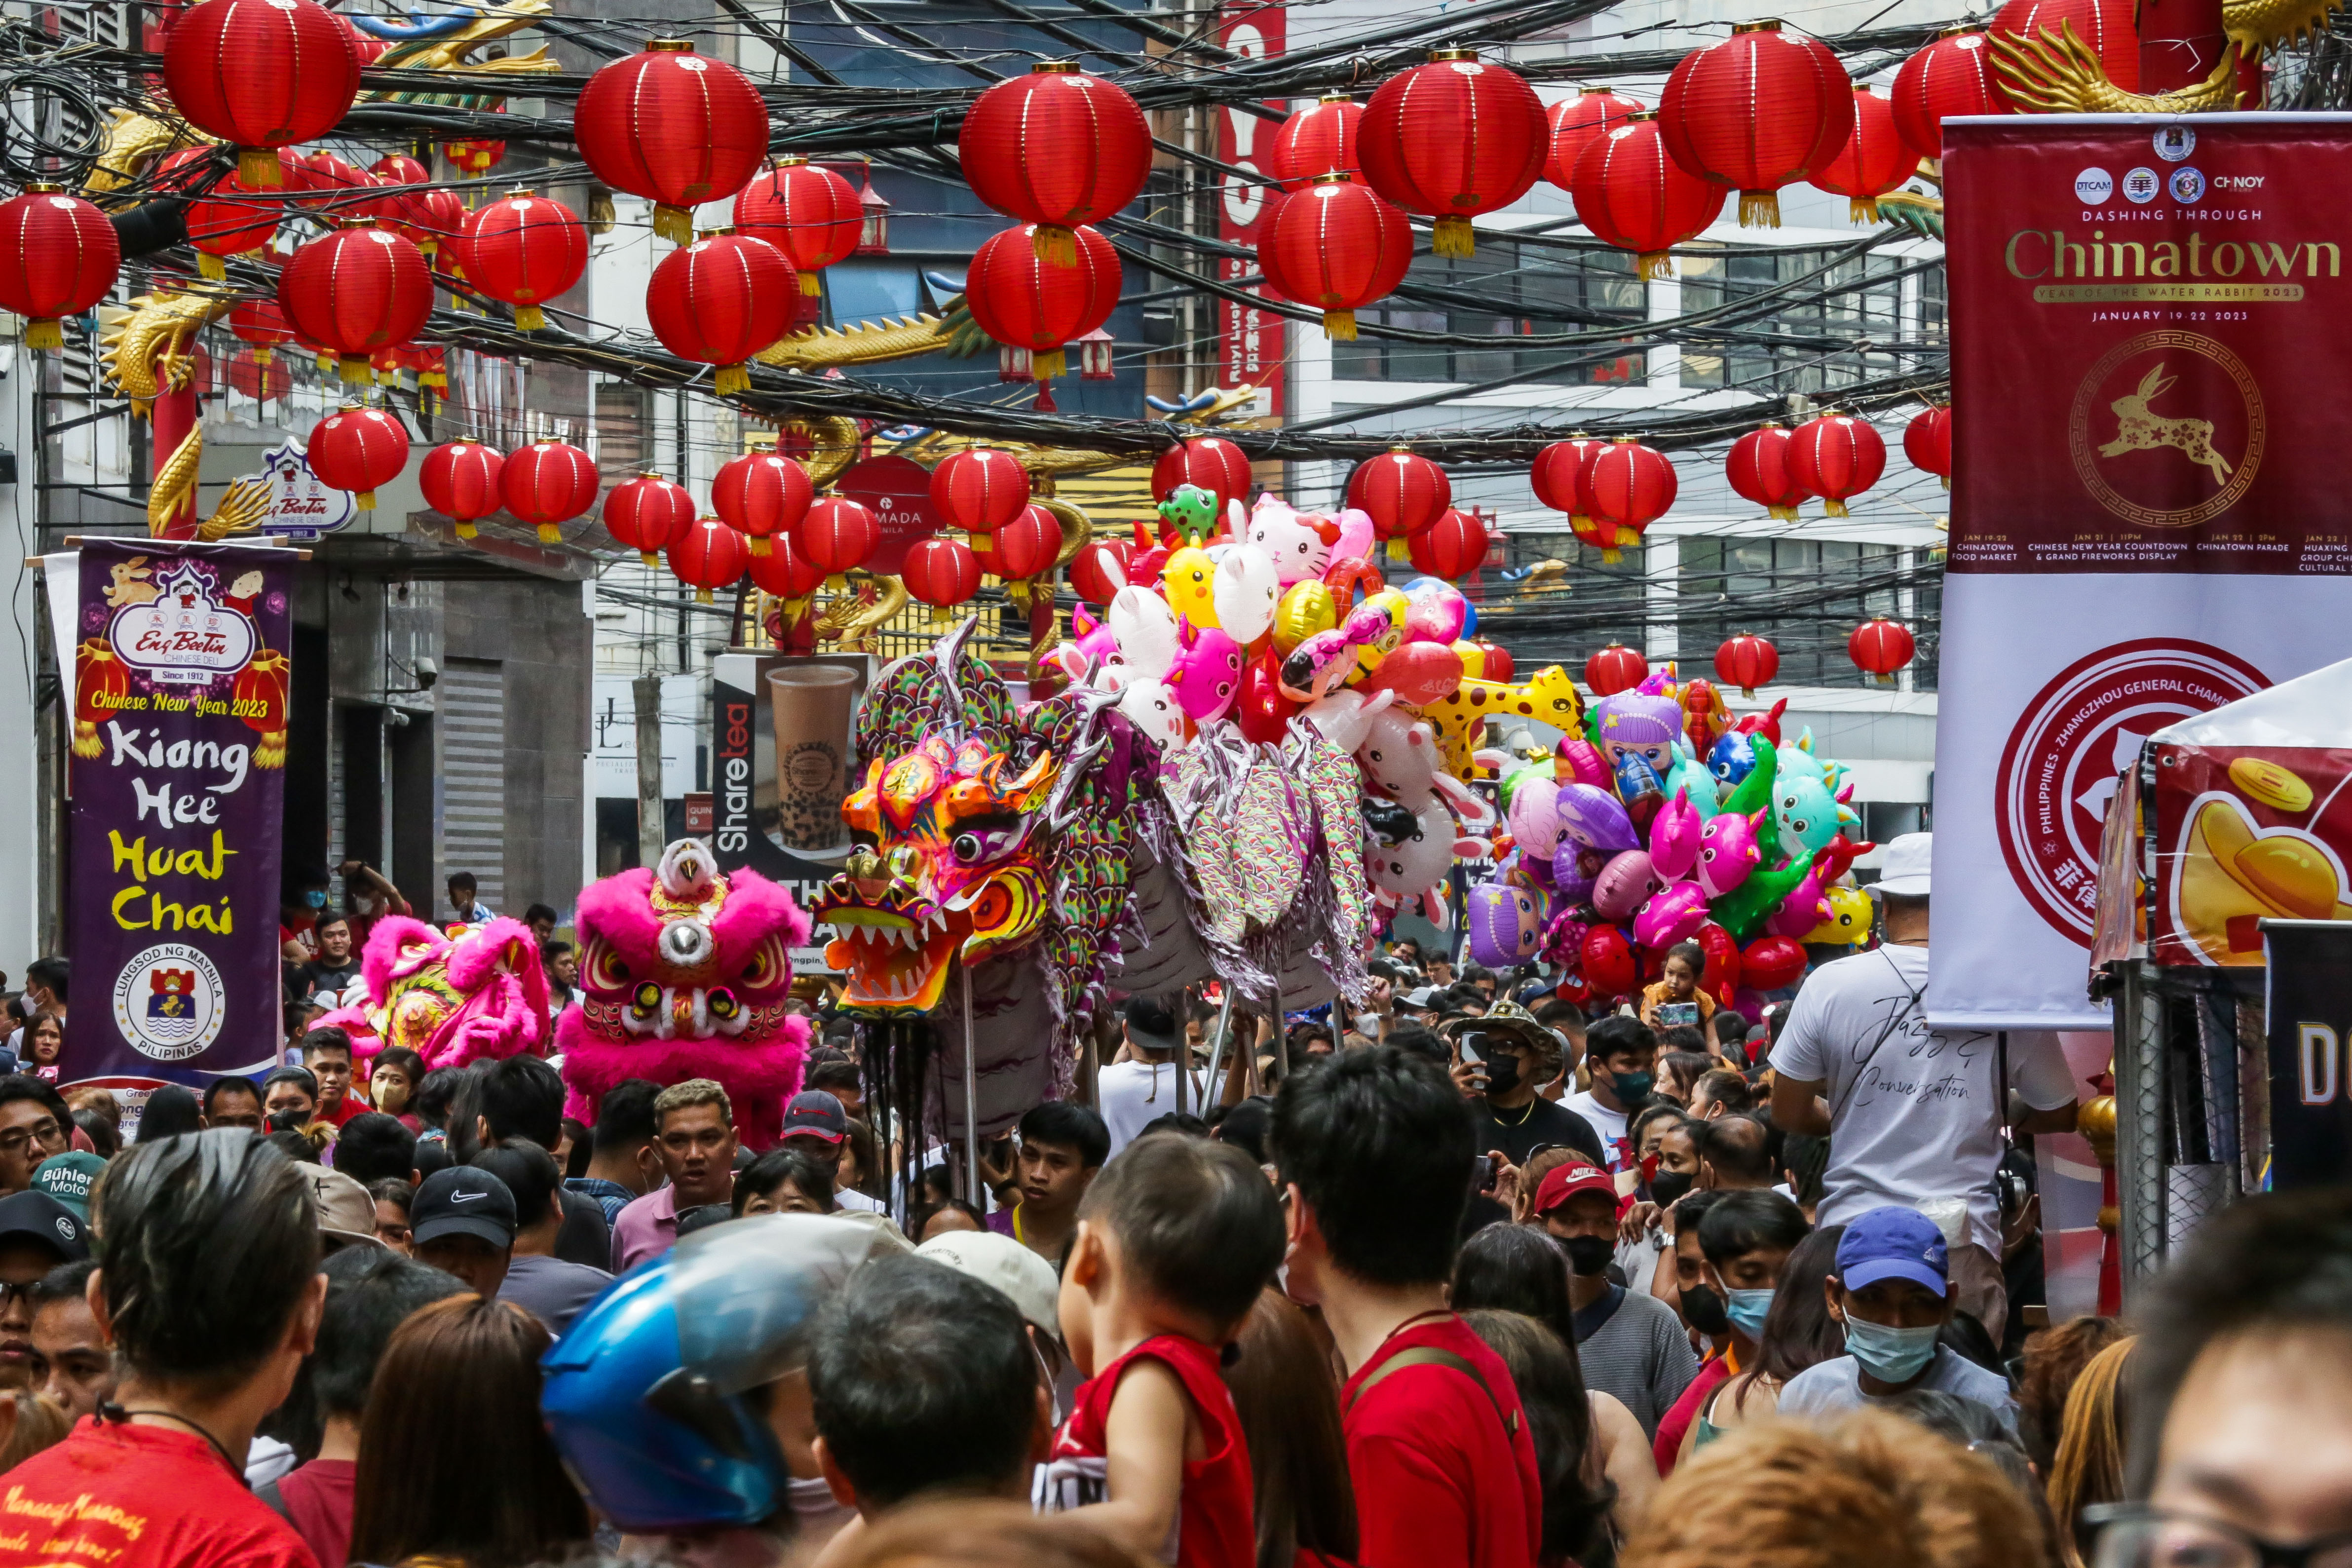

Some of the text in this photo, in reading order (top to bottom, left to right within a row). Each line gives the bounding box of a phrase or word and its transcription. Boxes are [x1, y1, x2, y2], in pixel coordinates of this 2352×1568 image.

[2077, 181, 2111, 191] DTCAM
[2083, 210, 2262, 222] DASHING THROUGH
[2004, 229, 2341, 279] Chinatown
[2039, 288, 2300, 297] YEAR OF THE WATER RABBIT 2023
[1230, 301, 1241, 341] Luck
[2092, 311, 2162, 322] JANUARY
[2215, 312, 2248, 321] 2023
[1229, 344, 1242, 382] Ruyi
[875, 512, 922, 524] MADA
[164, 653, 219, 665] CHINESE DELI
[162, 671, 204, 681] Since 1912
[91, 689, 268, 718] Chinese New Year 2023
[107, 720, 249, 794] Kiang
[2039, 753, 2059, 834] PHILIPPINES
[2055, 688, 2122, 747] ZHANGZHOU
[2124, 679, 2182, 695] GENERAL
[718, 703, 749, 853] Sharetea
[132, 777, 221, 829] Hee
[108, 829, 239, 882] Huat
[112, 886, 233, 935] Chai
[116, 947, 223, 998] LUNGSOD NG MAYNILA
[790, 956, 823, 965] ngpin,
[137, 1040, 202, 1059] PILIPINAS
[2297, 1022, 2352, 1106] D
[1854, 1066, 1970, 1107] Conversation
[41, 1167, 94, 1184] Bühler
[1571, 1167, 1597, 1178] NIKE
